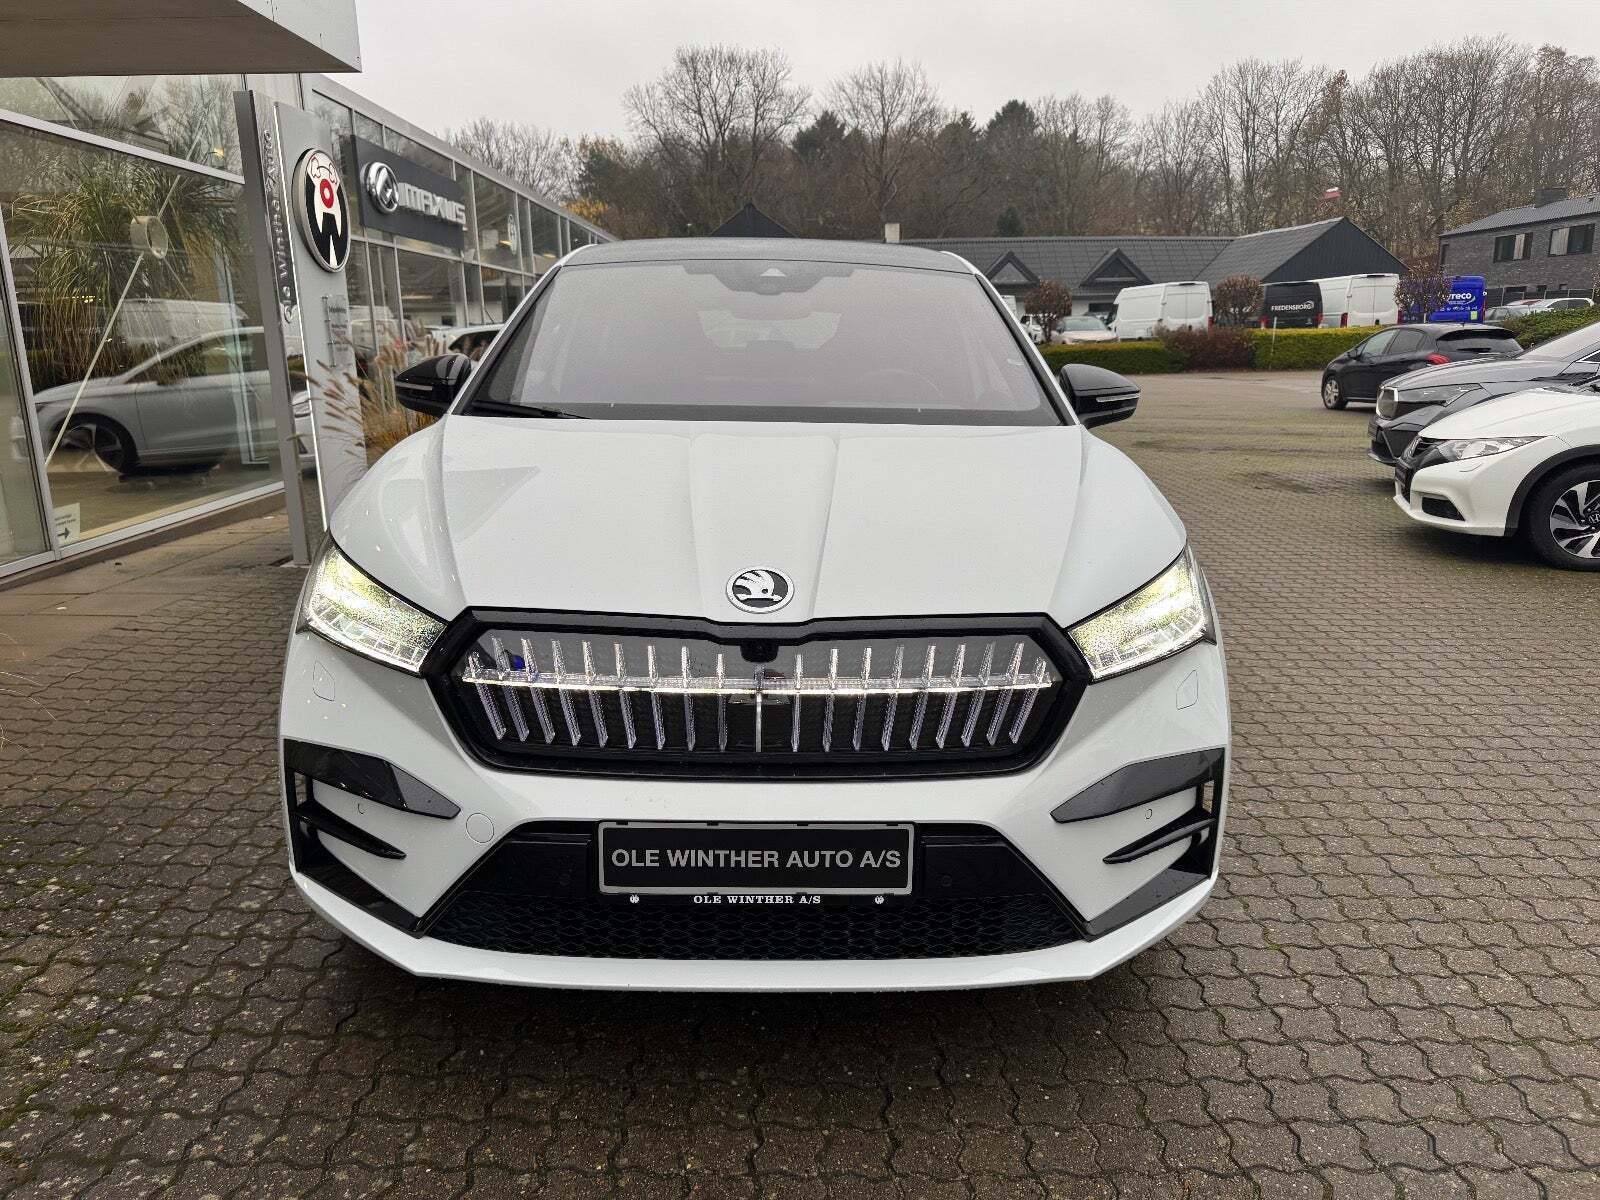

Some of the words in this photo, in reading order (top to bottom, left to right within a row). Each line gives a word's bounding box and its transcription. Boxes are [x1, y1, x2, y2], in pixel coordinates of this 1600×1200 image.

[398, 182, 466, 225] MAXUS
[611, 848, 660, 868] OLE
[667, 848, 779, 868] WINTHER
[786, 849, 853, 869] AUTO
[860, 849, 901, 869] A/S
[693, 895, 722, 904] OLE
[727, 895, 795, 904] WINTHER
[799, 895, 821, 904] A/S
